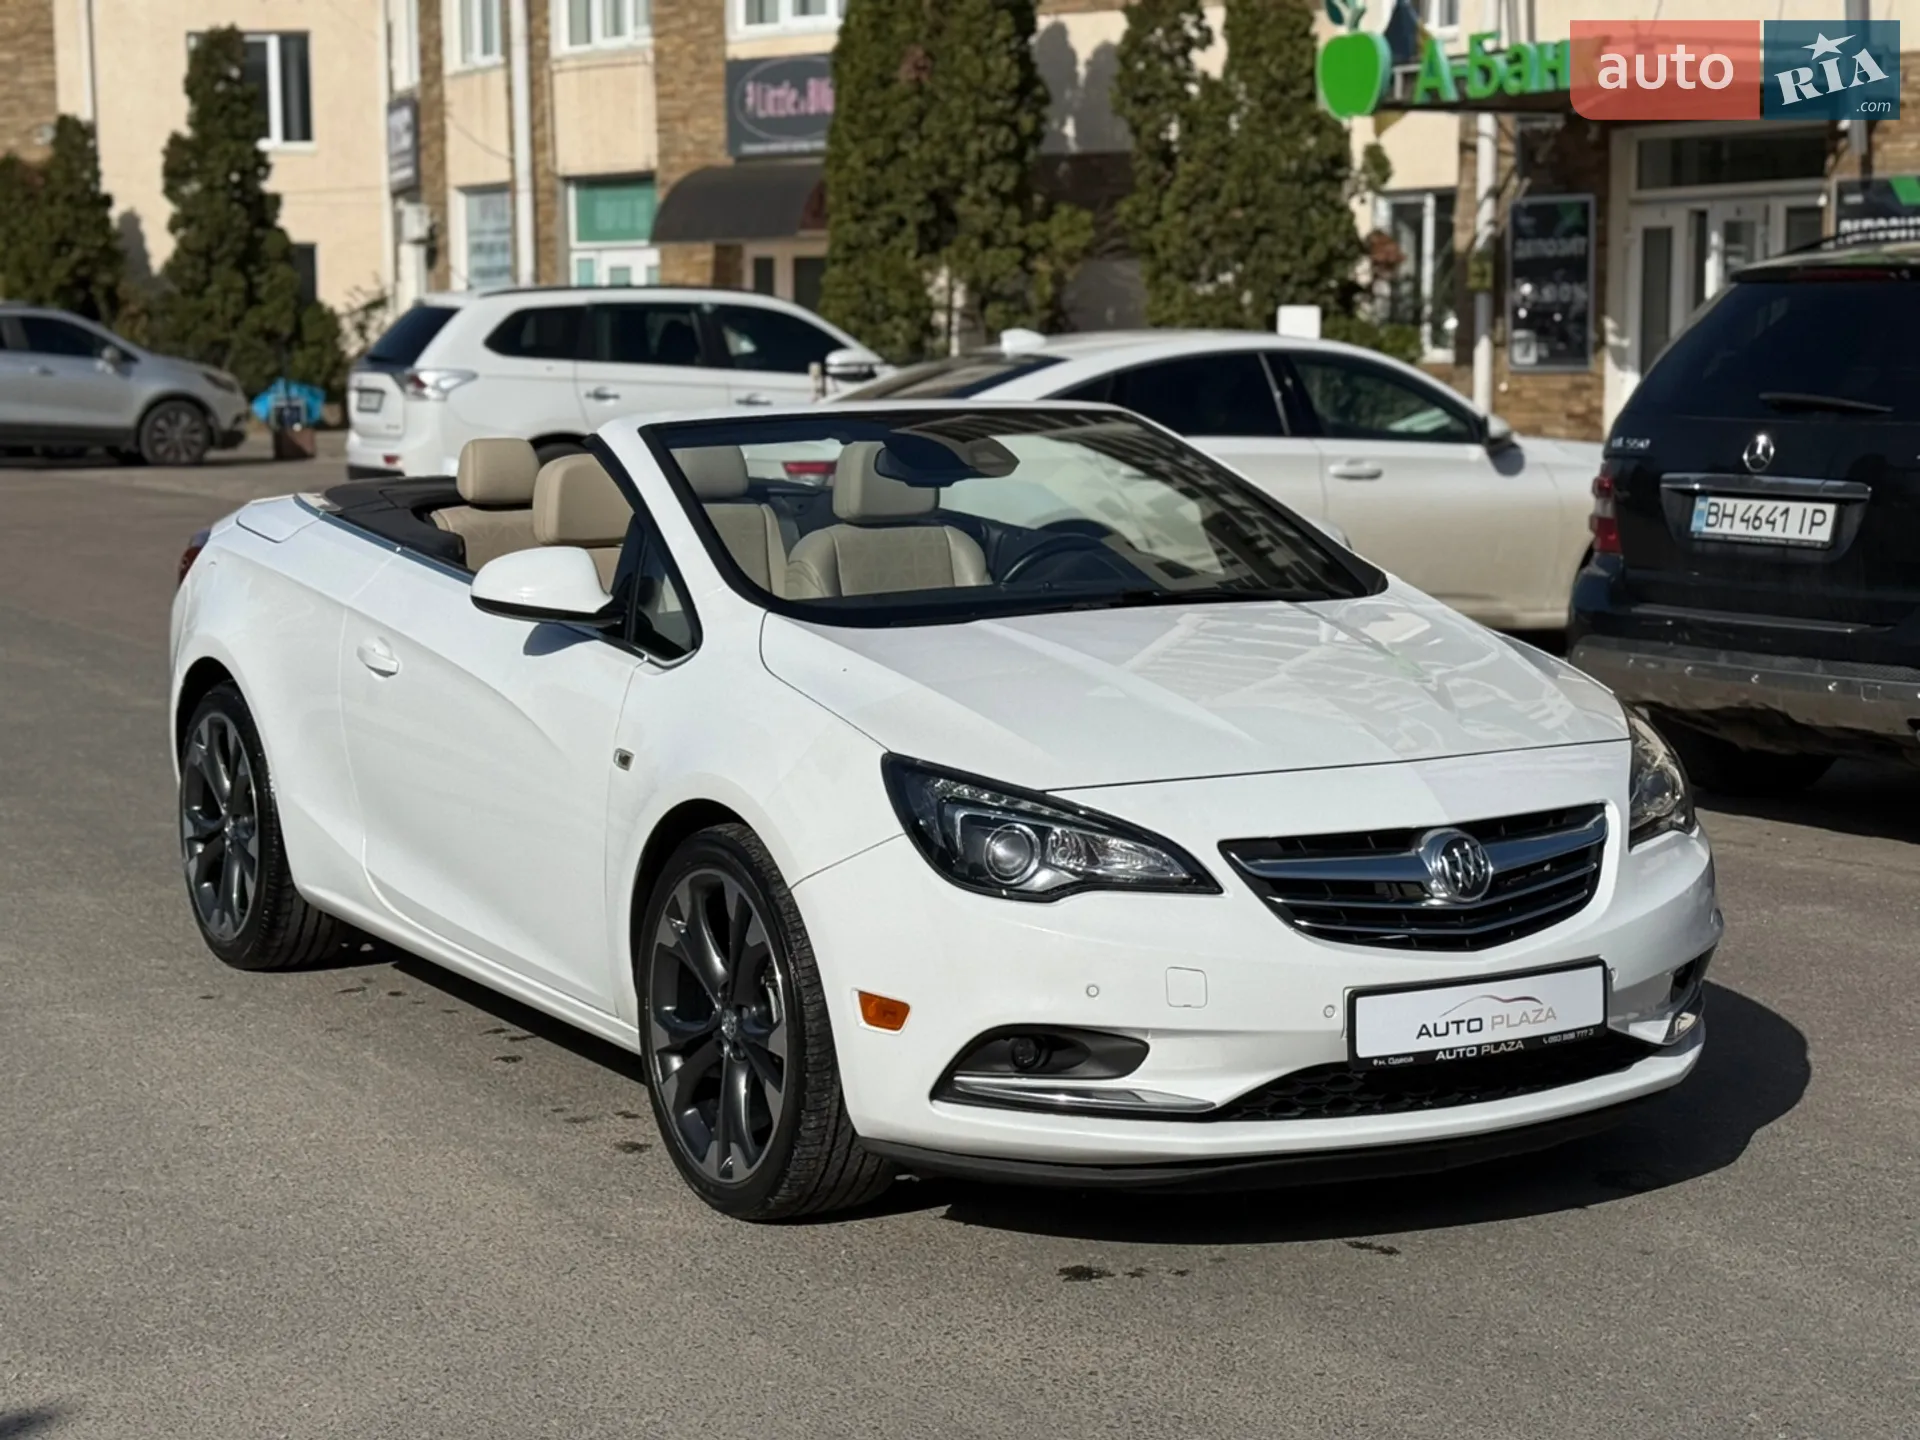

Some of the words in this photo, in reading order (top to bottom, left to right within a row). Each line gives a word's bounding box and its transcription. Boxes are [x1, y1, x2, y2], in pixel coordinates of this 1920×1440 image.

[1416, 1017, 1483, 1040] AUTO
[1491, 1006, 1557, 1031] PLAZA
[1435, 1046, 1477, 1061] AUTO
[1481, 1040, 1525, 1056] PLAZA
